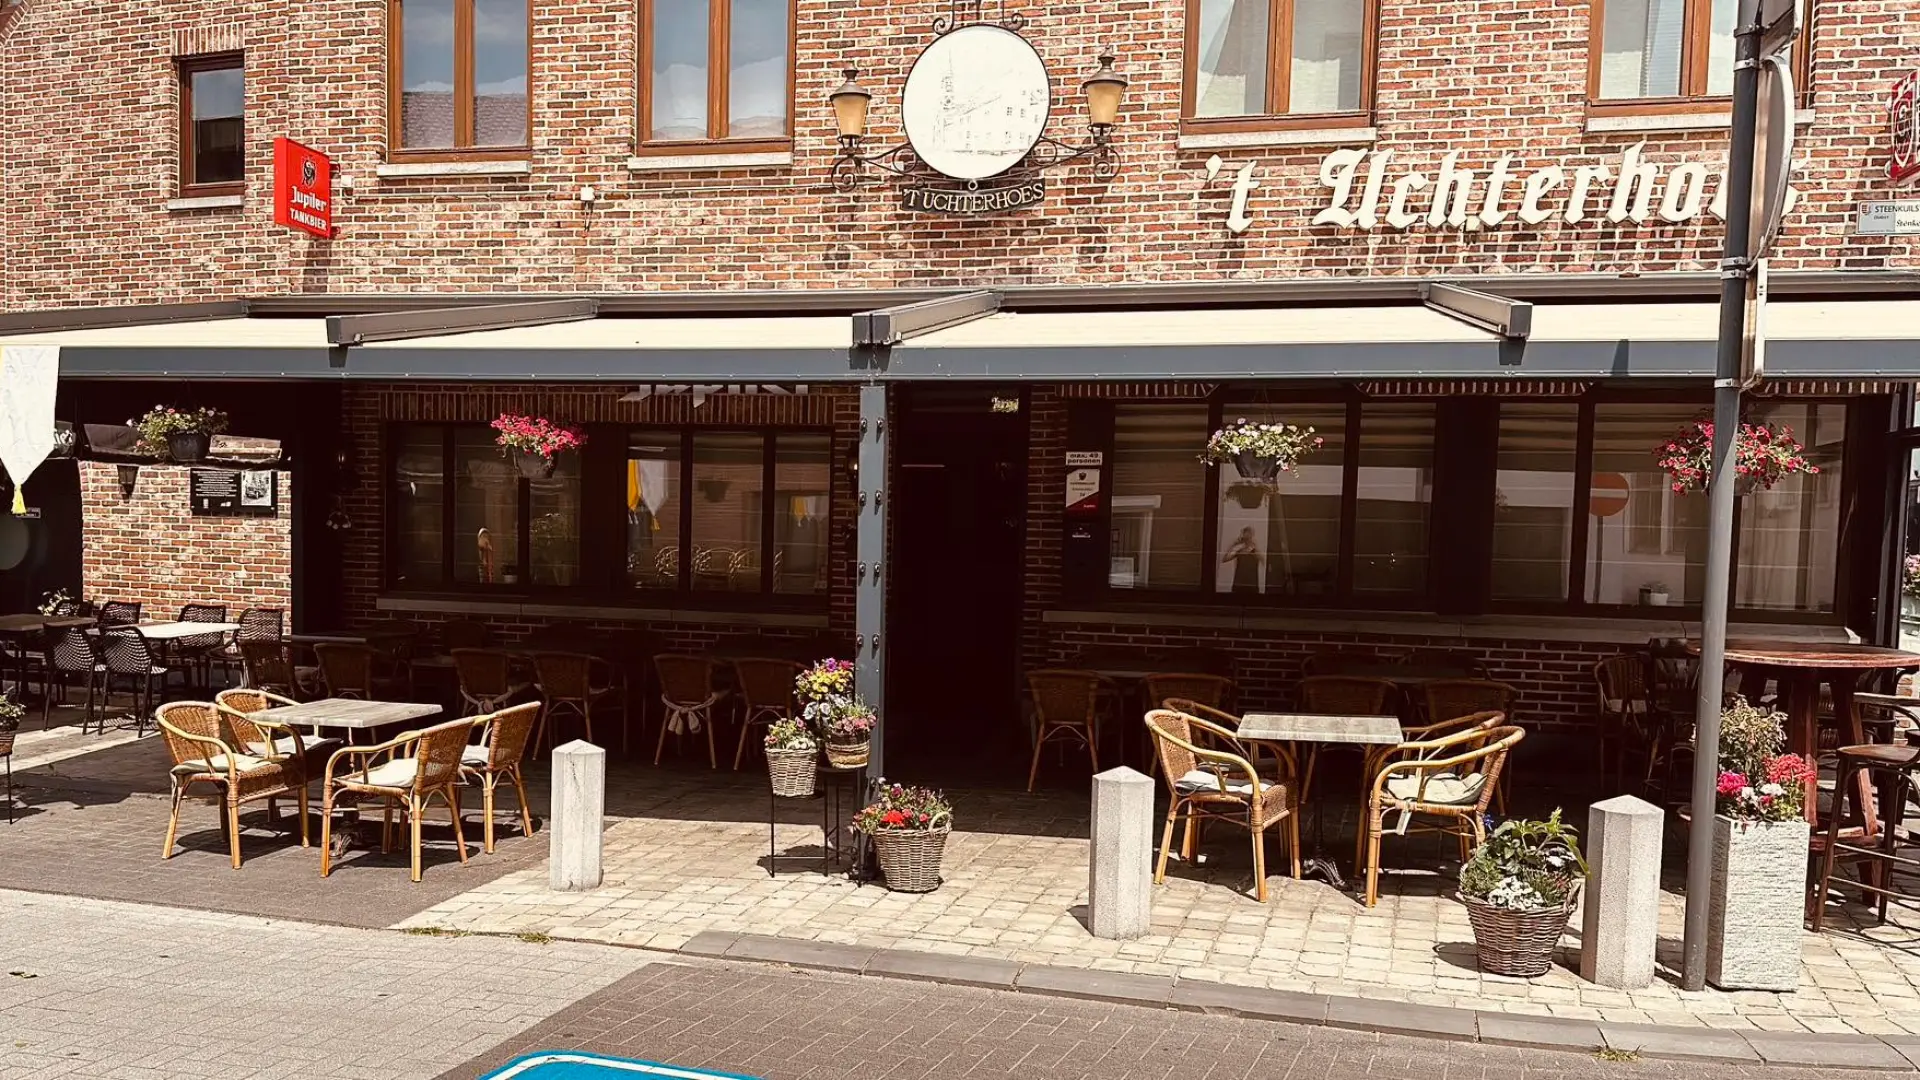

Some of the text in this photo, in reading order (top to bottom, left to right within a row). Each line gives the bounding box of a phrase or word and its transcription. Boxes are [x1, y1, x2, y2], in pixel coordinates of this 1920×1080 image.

[290, 185, 327, 212] Jupiler
[903, 183, 1044, 213] 'T UCHTERHOES
[1204, 139, 1808, 234] 't Uchterho
[289, 207, 327, 231] TANKBIER
